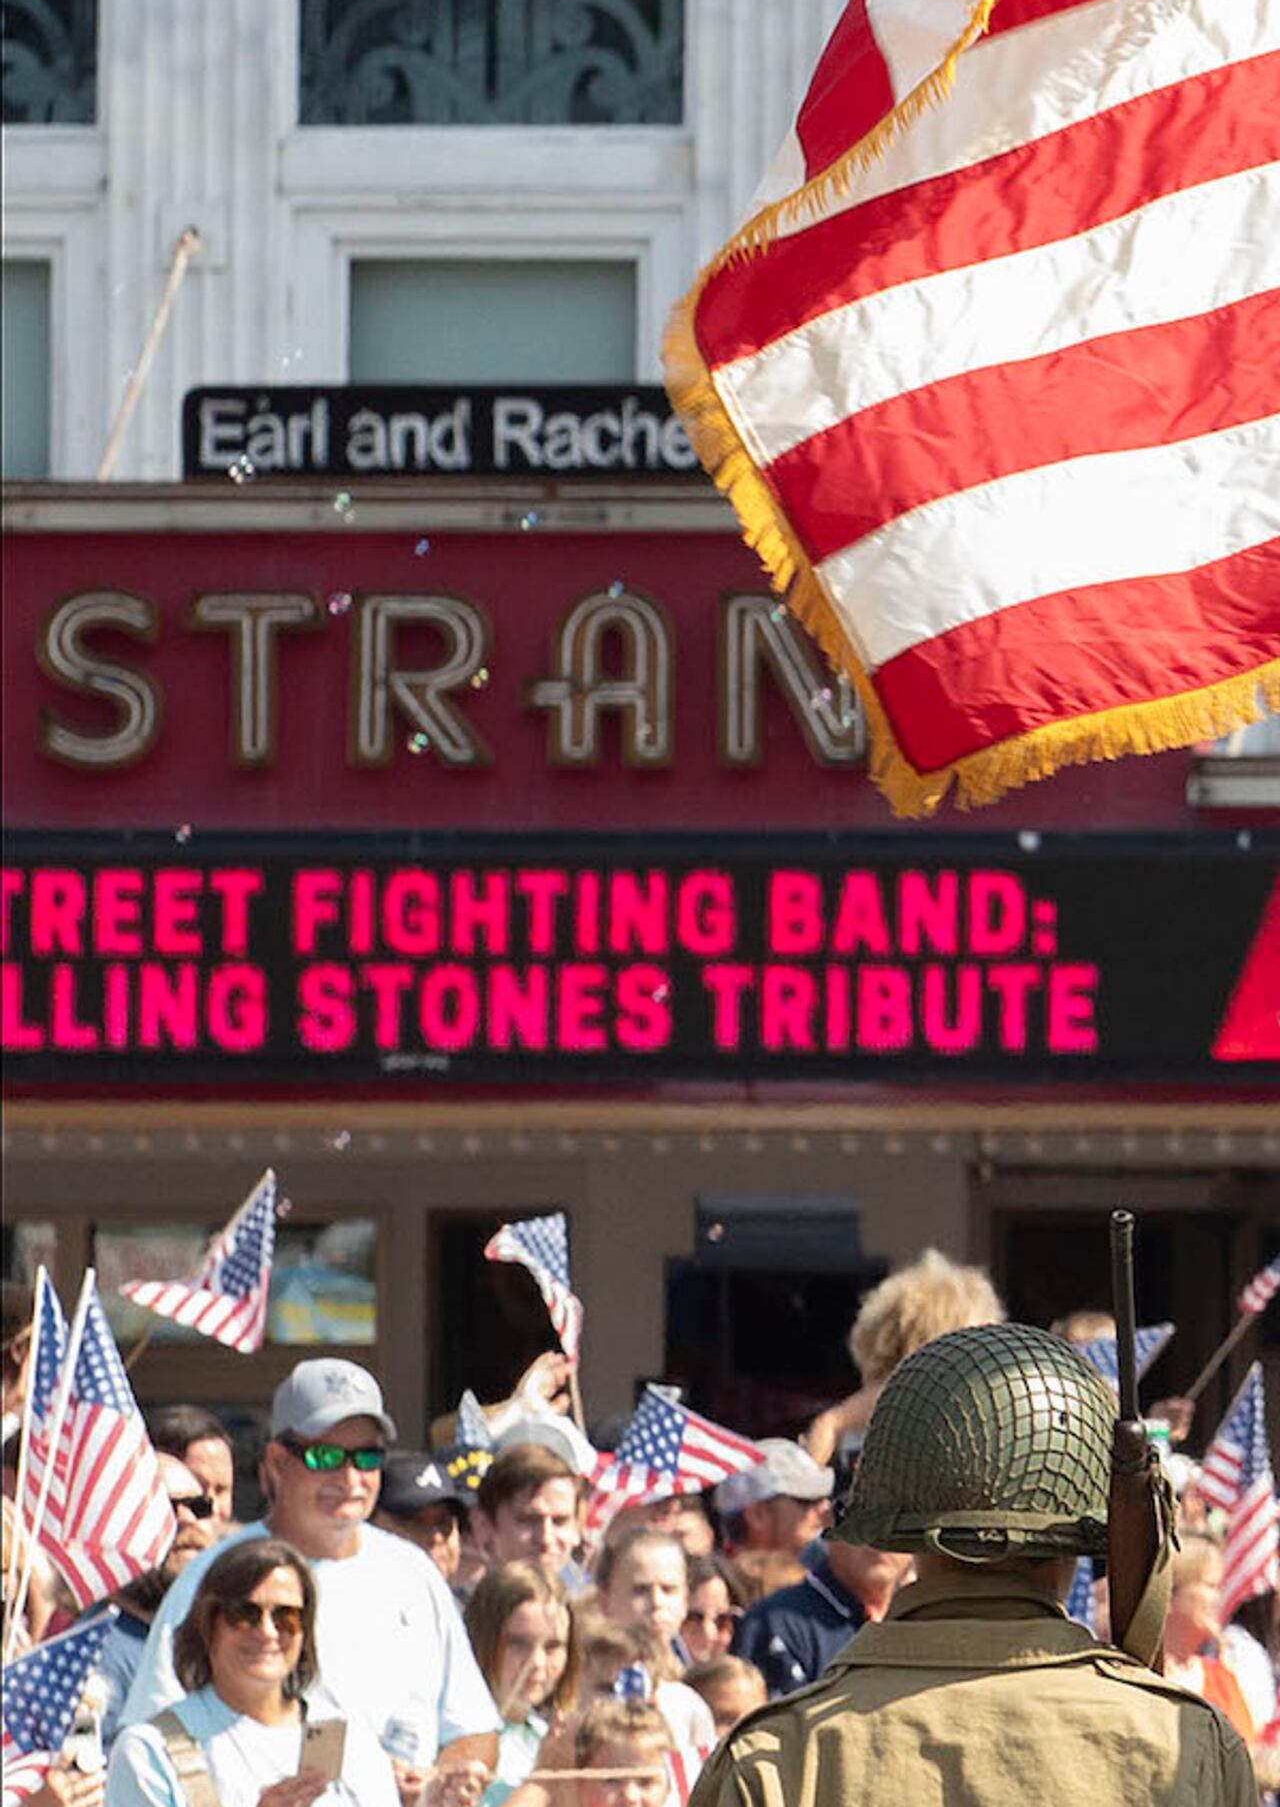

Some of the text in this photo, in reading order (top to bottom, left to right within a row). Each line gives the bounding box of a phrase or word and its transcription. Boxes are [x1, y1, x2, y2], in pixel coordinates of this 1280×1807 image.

[200, 396, 326, 471] Earl
[345, 396, 470, 471] and
[36, 590, 868, 767] STRAN
[292, 867, 735, 956] FIGHTING
[768, 867, 1058, 956] BAND:
[0, 961, 1099, 1054] LLING STONES TRIBUTE
